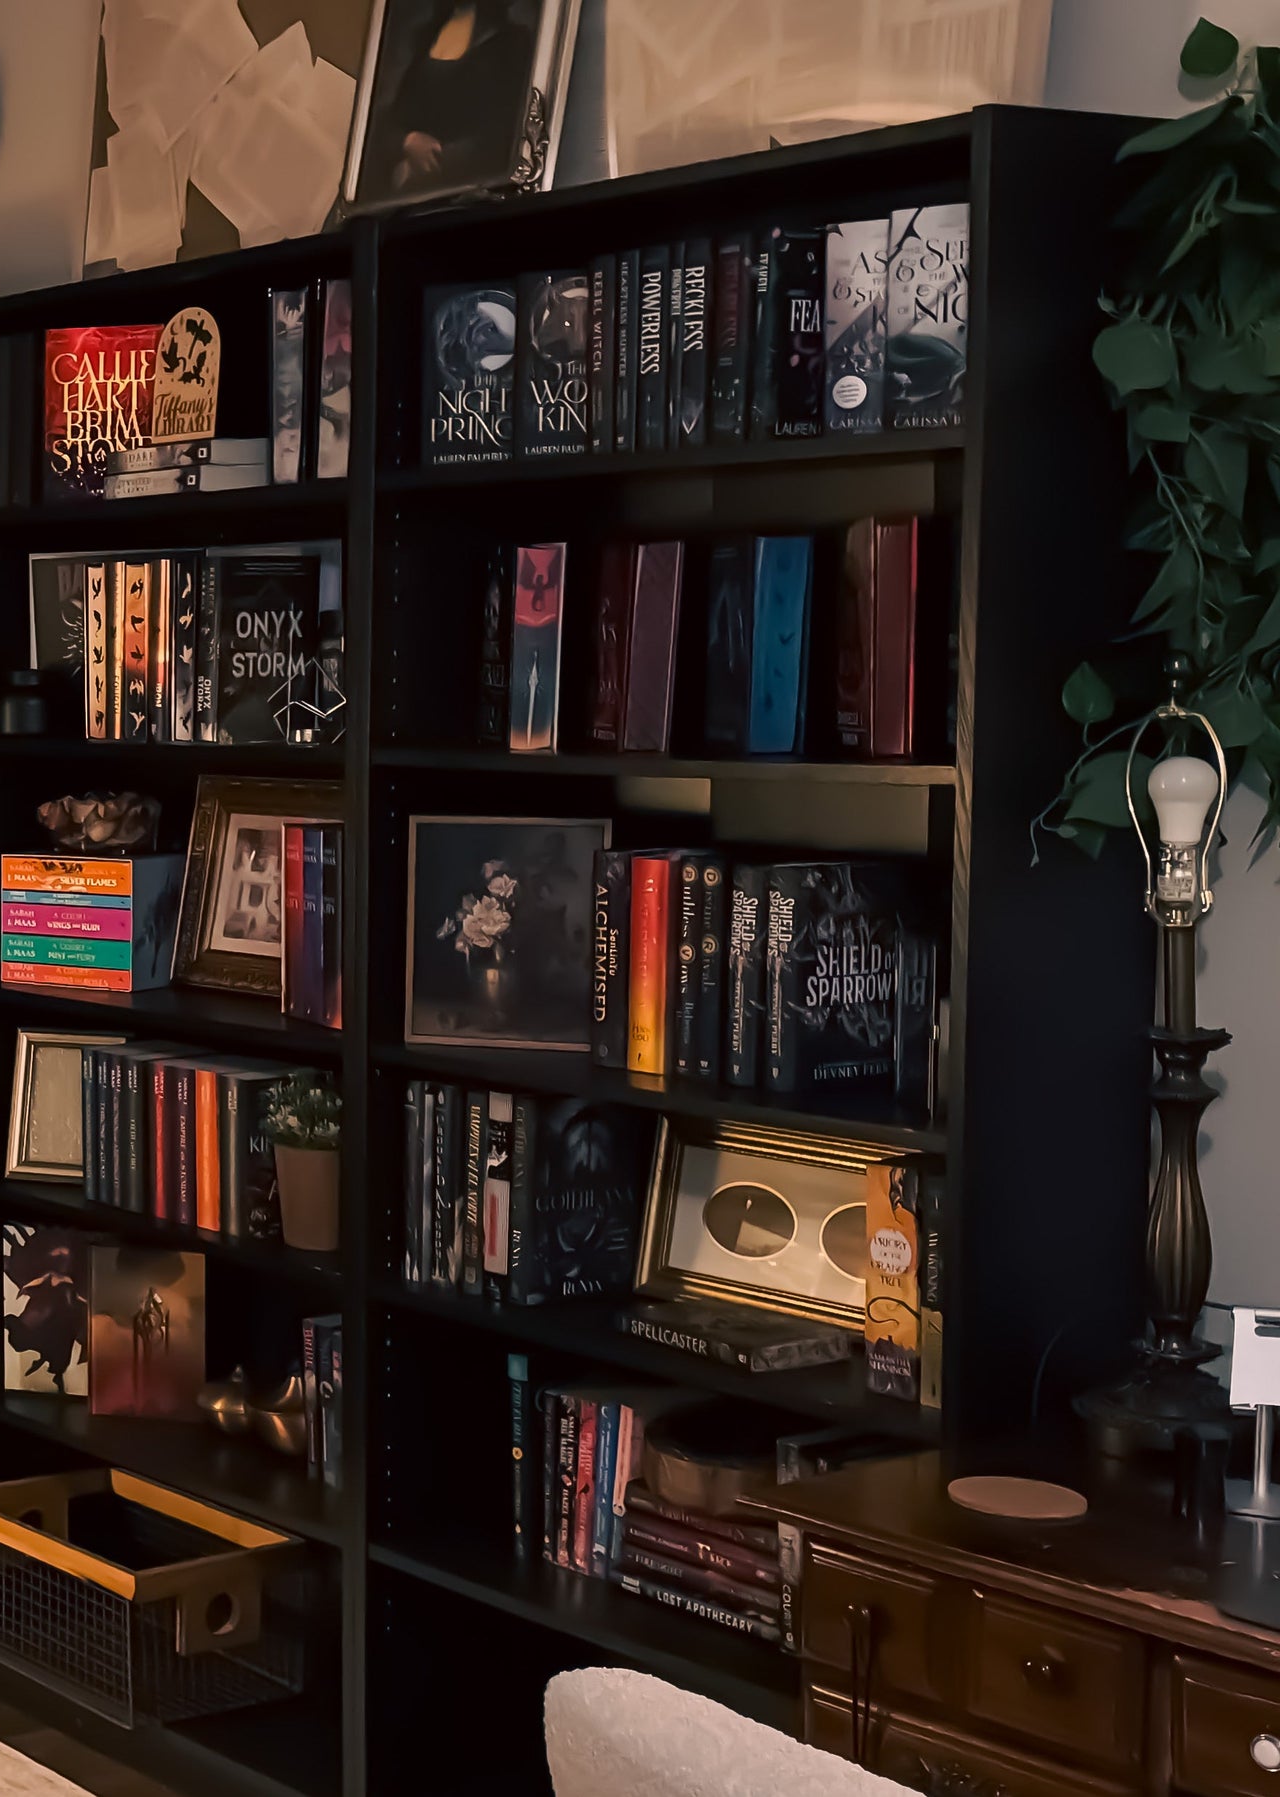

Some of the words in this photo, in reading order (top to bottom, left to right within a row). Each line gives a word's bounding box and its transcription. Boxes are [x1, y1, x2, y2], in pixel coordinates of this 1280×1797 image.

[593, 271, 603, 315] REBEL
[683, 265, 706, 352] RECKLESS
[640, 271, 662, 376] POWERLESS
[790, 299, 821, 332] FEA
[51, 350, 157, 385] CALLIE
[63, 380, 148, 413] HART
[66, 409, 144, 441] BRIM
[538, 400, 587, 433] KIN
[893, 416, 948, 429] CARISSA
[236, 611, 303, 639] ONYX
[232, 652, 306, 678] STORM
[86, 877, 118, 887] FLAMES
[742, 896, 759, 943] SHIELD
[778, 897, 795, 943] SHIELD
[594, 883, 609, 1023] ALCHEMISED
[816, 943, 882, 977] SHIELD
[806, 974, 893, 1007] SPARROW
[630, 1319, 709, 1355] SPELLCASTER
[656, 1589, 683, 1608] LOST
[685, 1600, 754, 1634] APOTHECARY
